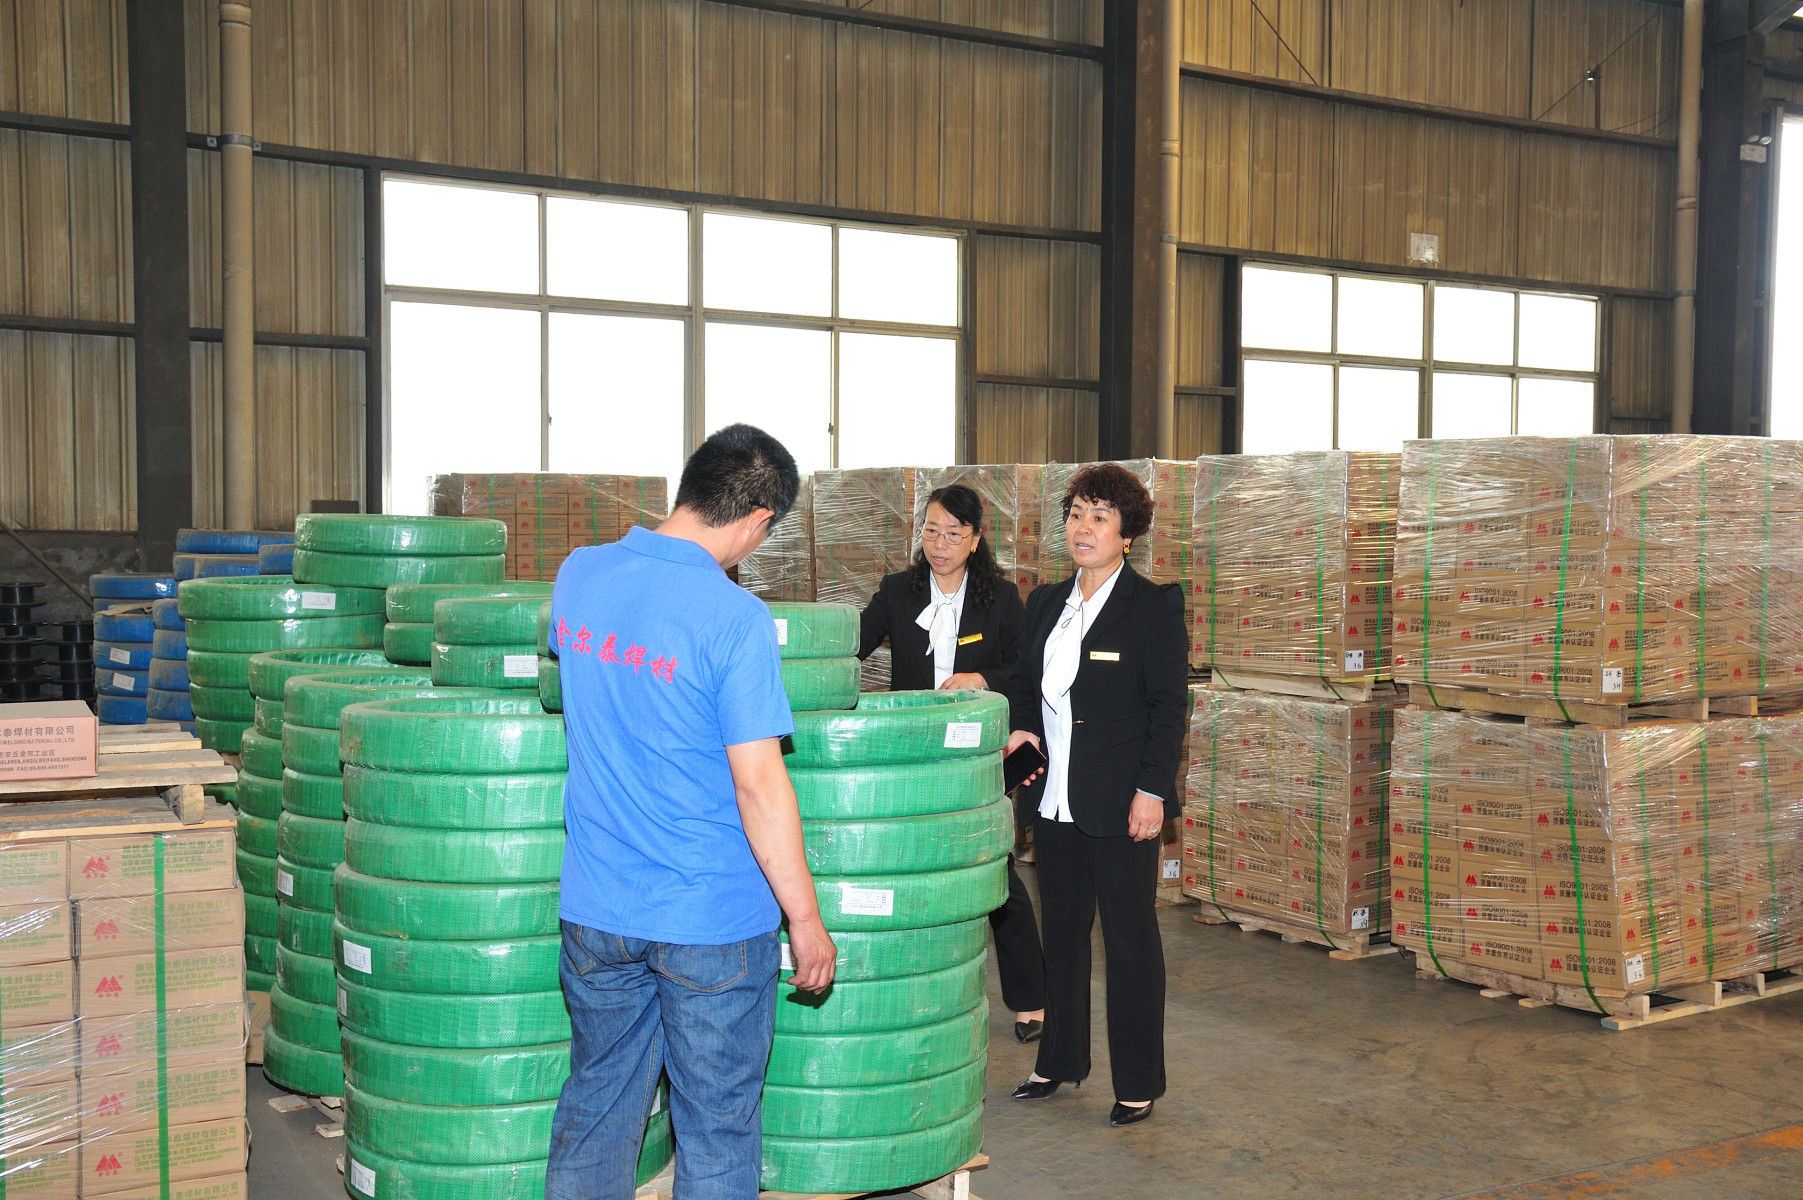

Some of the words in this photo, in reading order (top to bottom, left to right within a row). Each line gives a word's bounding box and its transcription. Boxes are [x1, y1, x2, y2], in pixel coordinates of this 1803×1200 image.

[1410, 617, 1451, 628] ISO901:2008
[0, 726, 75, 738] 泰焊材有限公司
[1557, 843, 1606, 854] ISO901:2008
[1407, 860, 1451, 872] 质量体认证企业
[1560, 880, 1609, 891] ISO901:2008
[1562, 916, 1612, 928] ISO901:2008
[1486, 941, 1532, 955] ISO9001:2008
[1566, 954, 1616, 966] ISO901:2008
